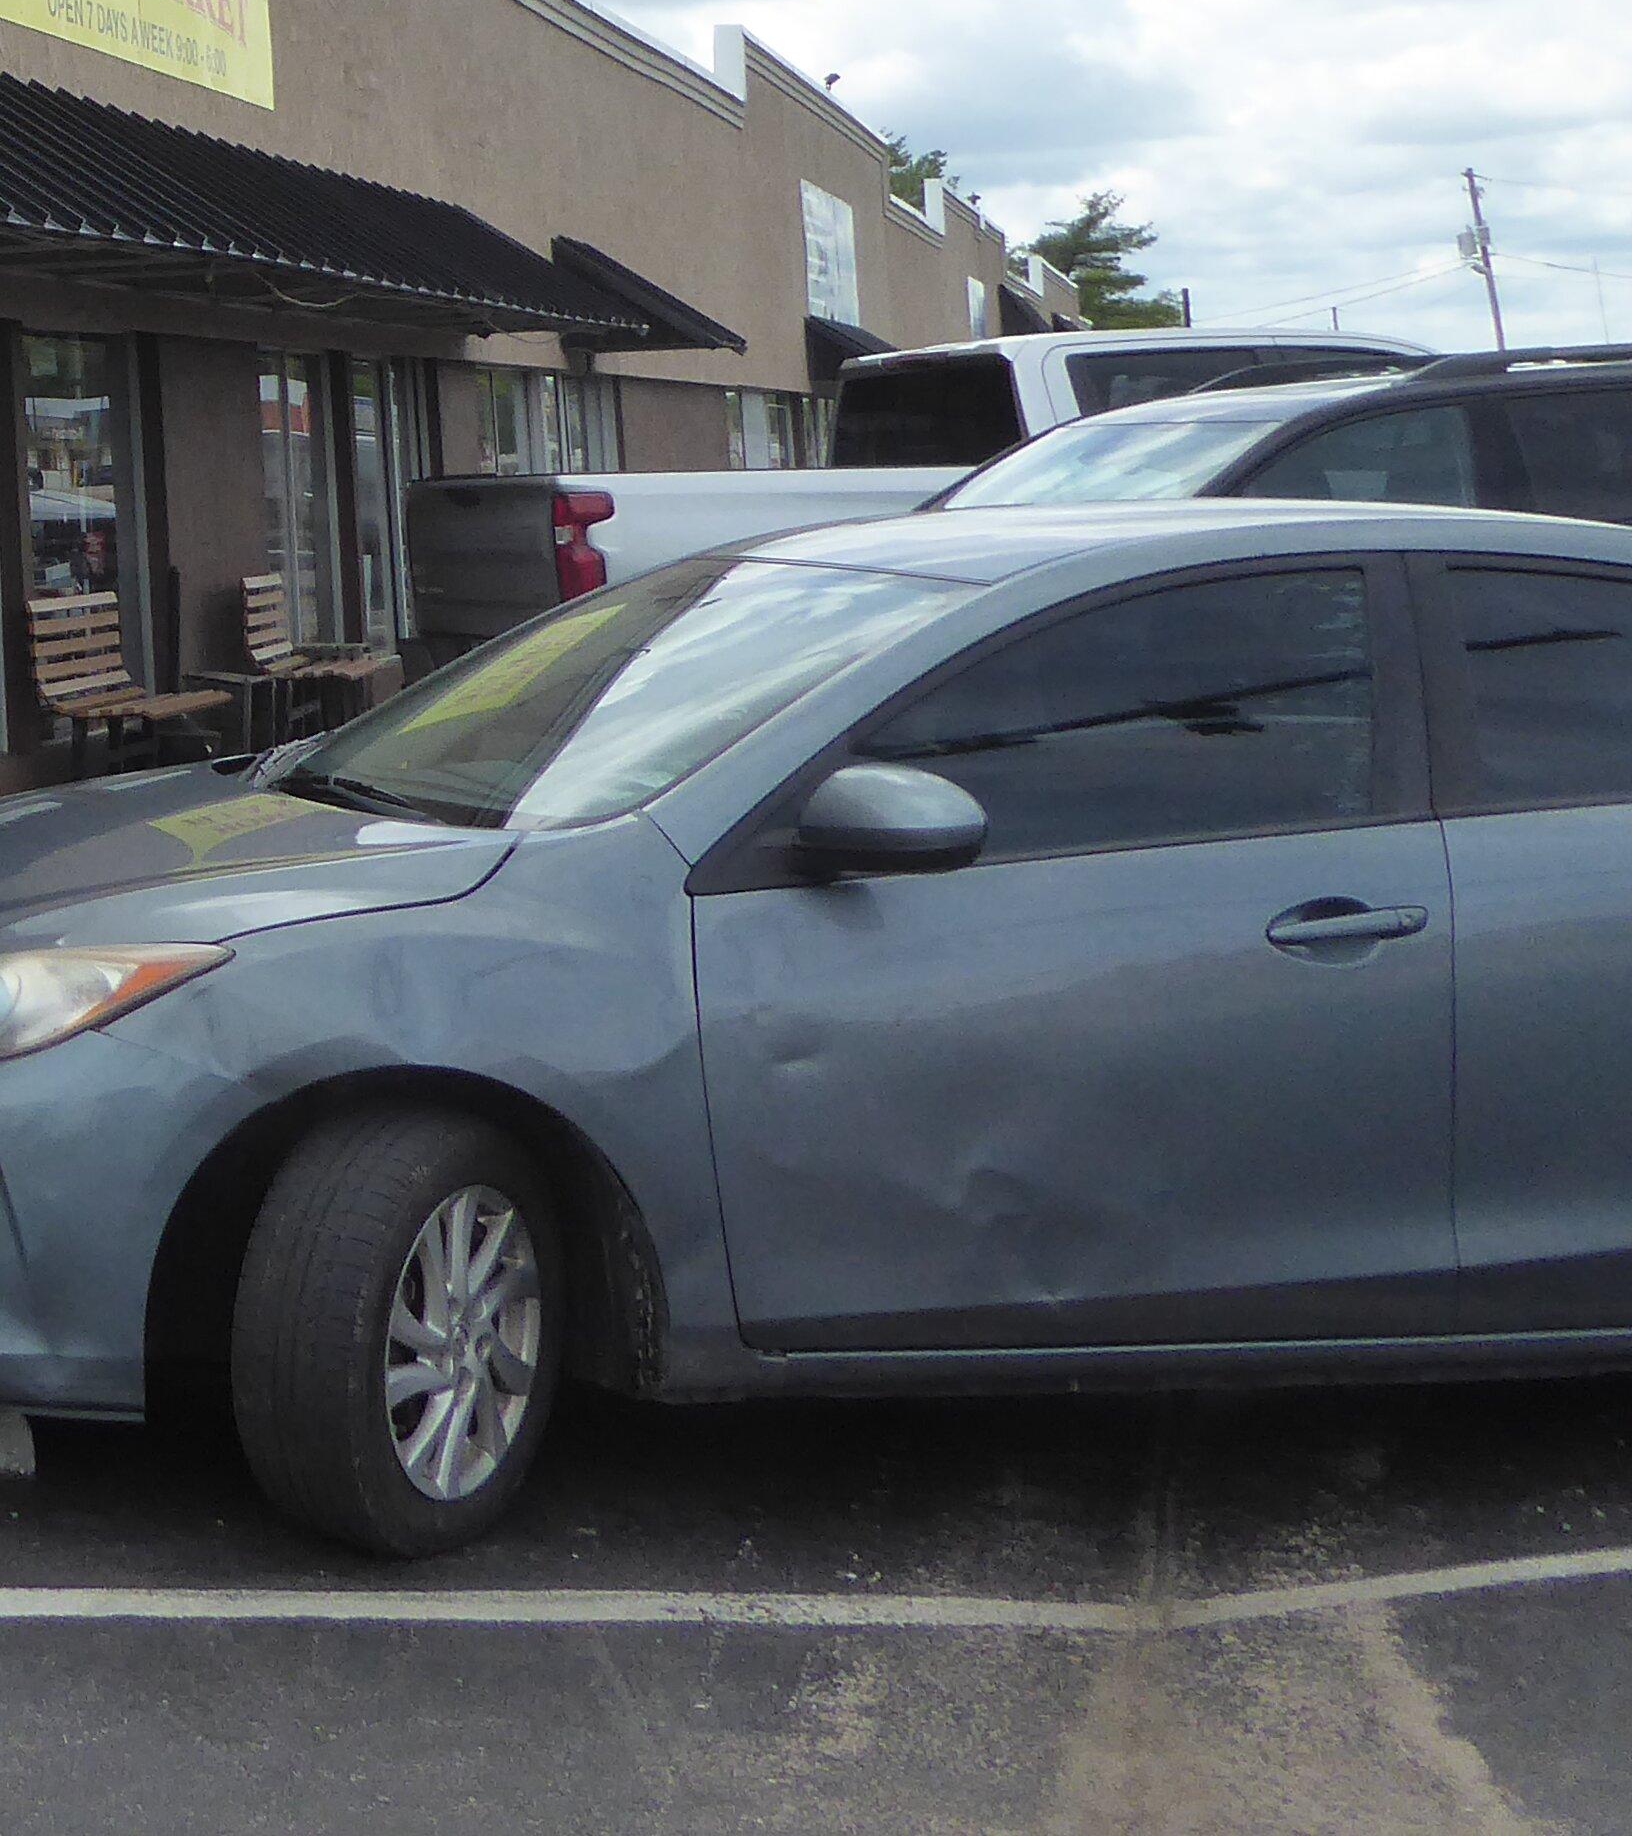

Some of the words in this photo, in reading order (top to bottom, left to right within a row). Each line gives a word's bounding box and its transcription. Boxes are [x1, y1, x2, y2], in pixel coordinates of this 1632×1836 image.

[86, 0, 93, 30] 7
[96, 2, 128, 43] DAYS
[139, 19, 174, 59] WEEK
